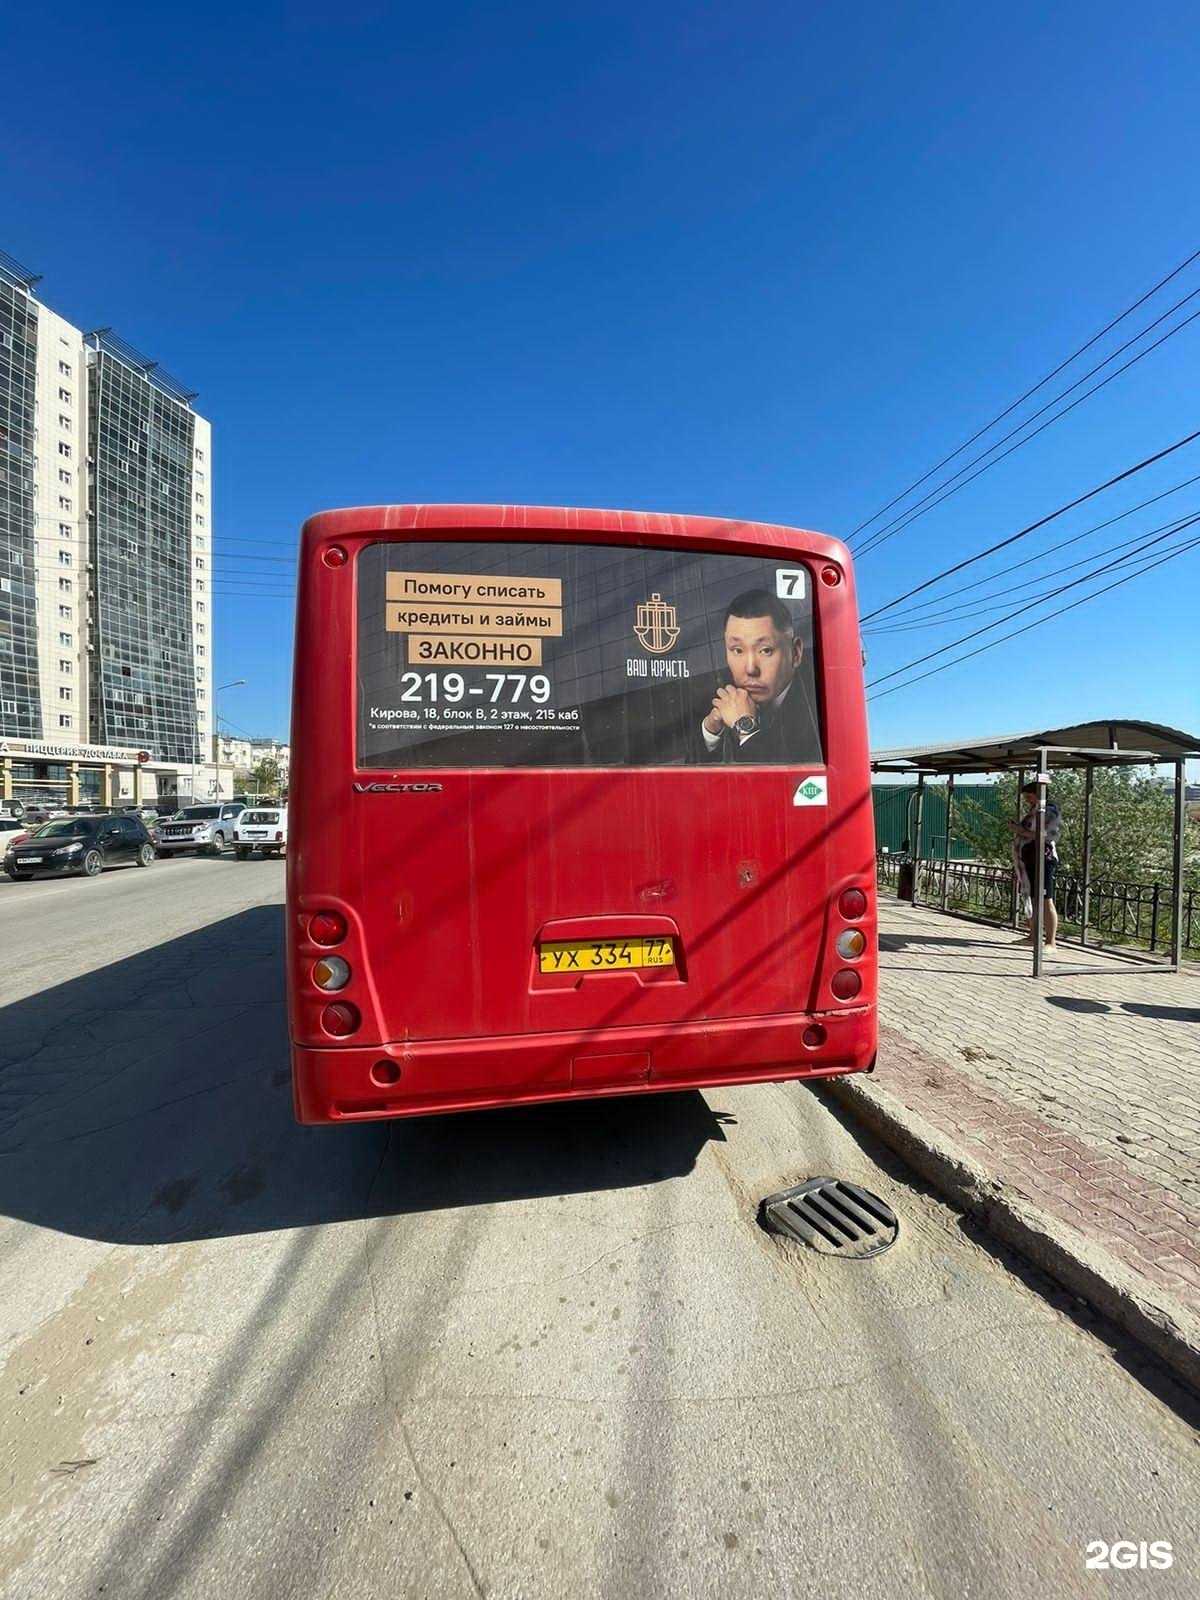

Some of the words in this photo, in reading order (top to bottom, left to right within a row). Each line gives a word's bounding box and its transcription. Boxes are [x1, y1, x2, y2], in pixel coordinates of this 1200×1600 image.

[404, 579, 472, 599] Помогу
[477, 584, 546, 599] списать
[782, 574, 799, 596] 7
[398, 611, 474, 626] кредиты
[479, 614, 490, 625] и
[495, 612, 552, 628] займы
[418, 641, 532, 661] ЗАКОННО
[626, 658, 648, 677] ВАШ
[400, 672, 551, 703] 219-779
[370, 707, 420, 720] Кирова,
[423, 708, 440, 720] 18,
[443, 708, 473, 719] блок
[490, 708, 498, 719] 2
[501, 710, 533, 721] этаж,
[535, 709, 556, 720] 215
[558, 709, 579, 720] каб
[352, 782, 443, 792] VECTOR
[590, 944, 632, 966] 334
[645, 939, 666, 957] 77
